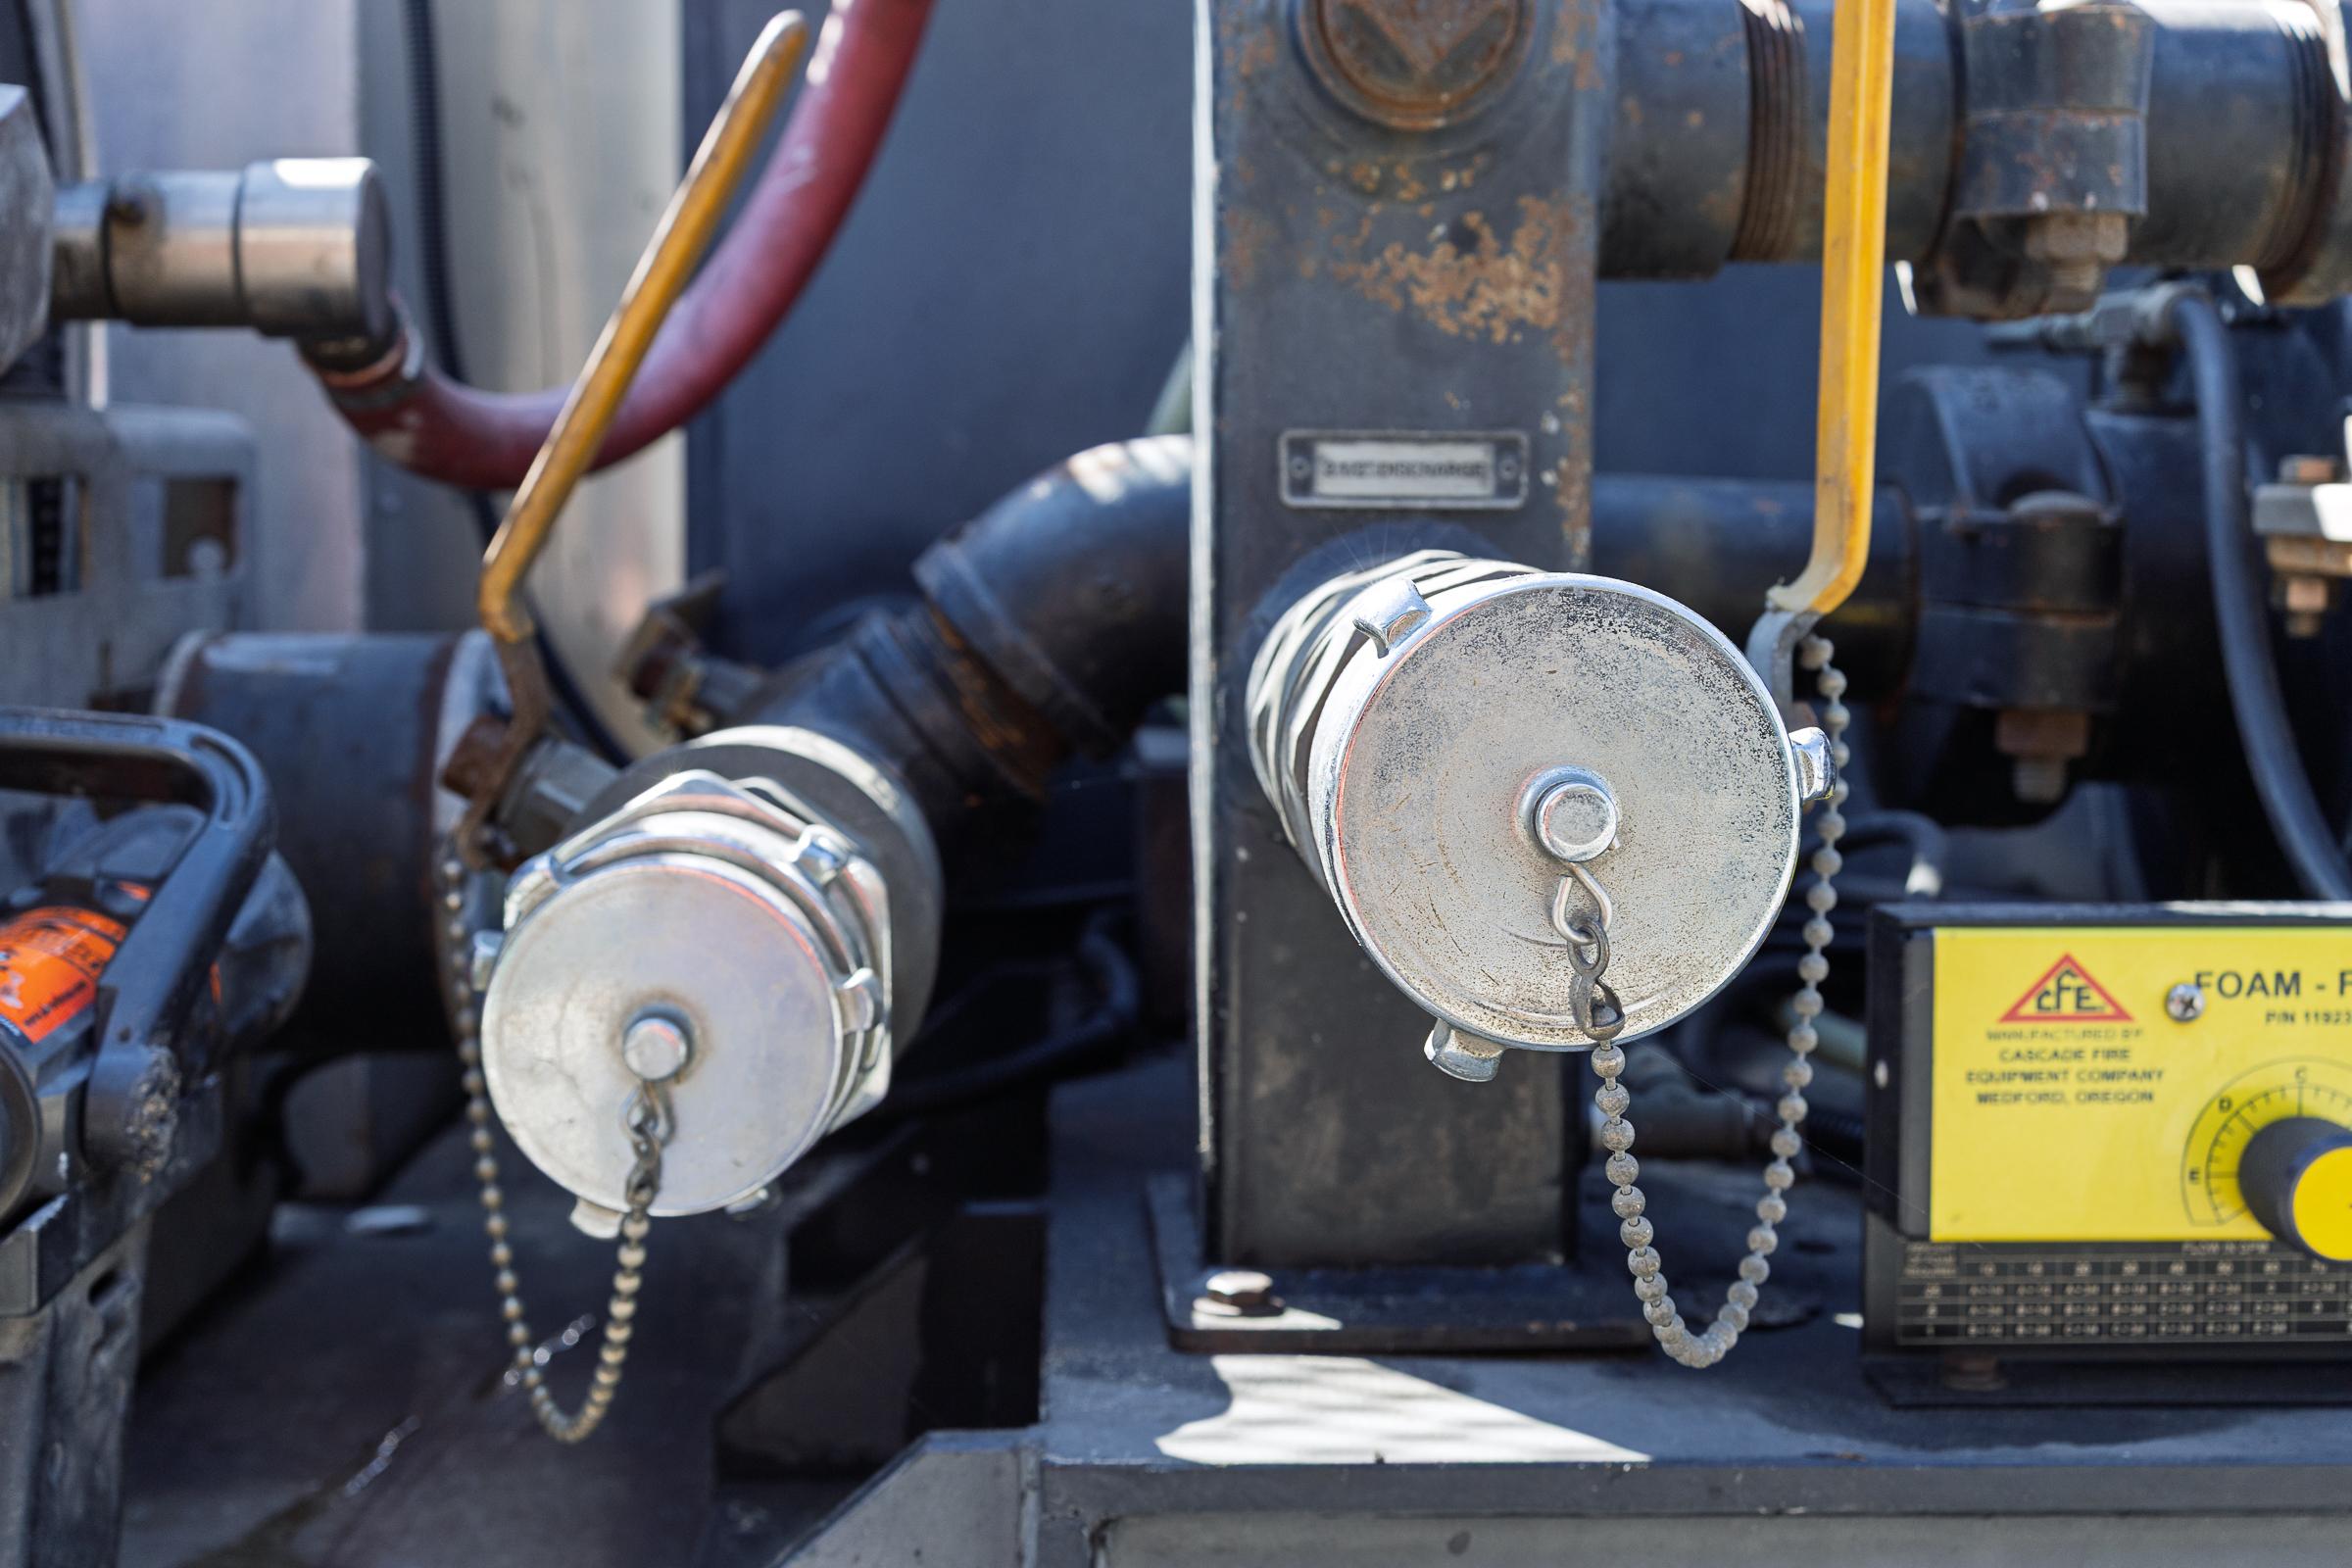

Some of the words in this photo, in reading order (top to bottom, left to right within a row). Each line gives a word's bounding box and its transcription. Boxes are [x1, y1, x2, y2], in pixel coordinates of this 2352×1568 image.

[2194, 969, 2302, 999] FOAM
[2000, 1050, 2085, 1061] CASCADE
[2092, 1049, 2131, 1060] FIRE
[1966, 1070, 2069, 1083] EQUIPMENT
[2077, 1070, 2164, 1082] COMPANY
[2076, 1091, 2155, 1103] OREGON
